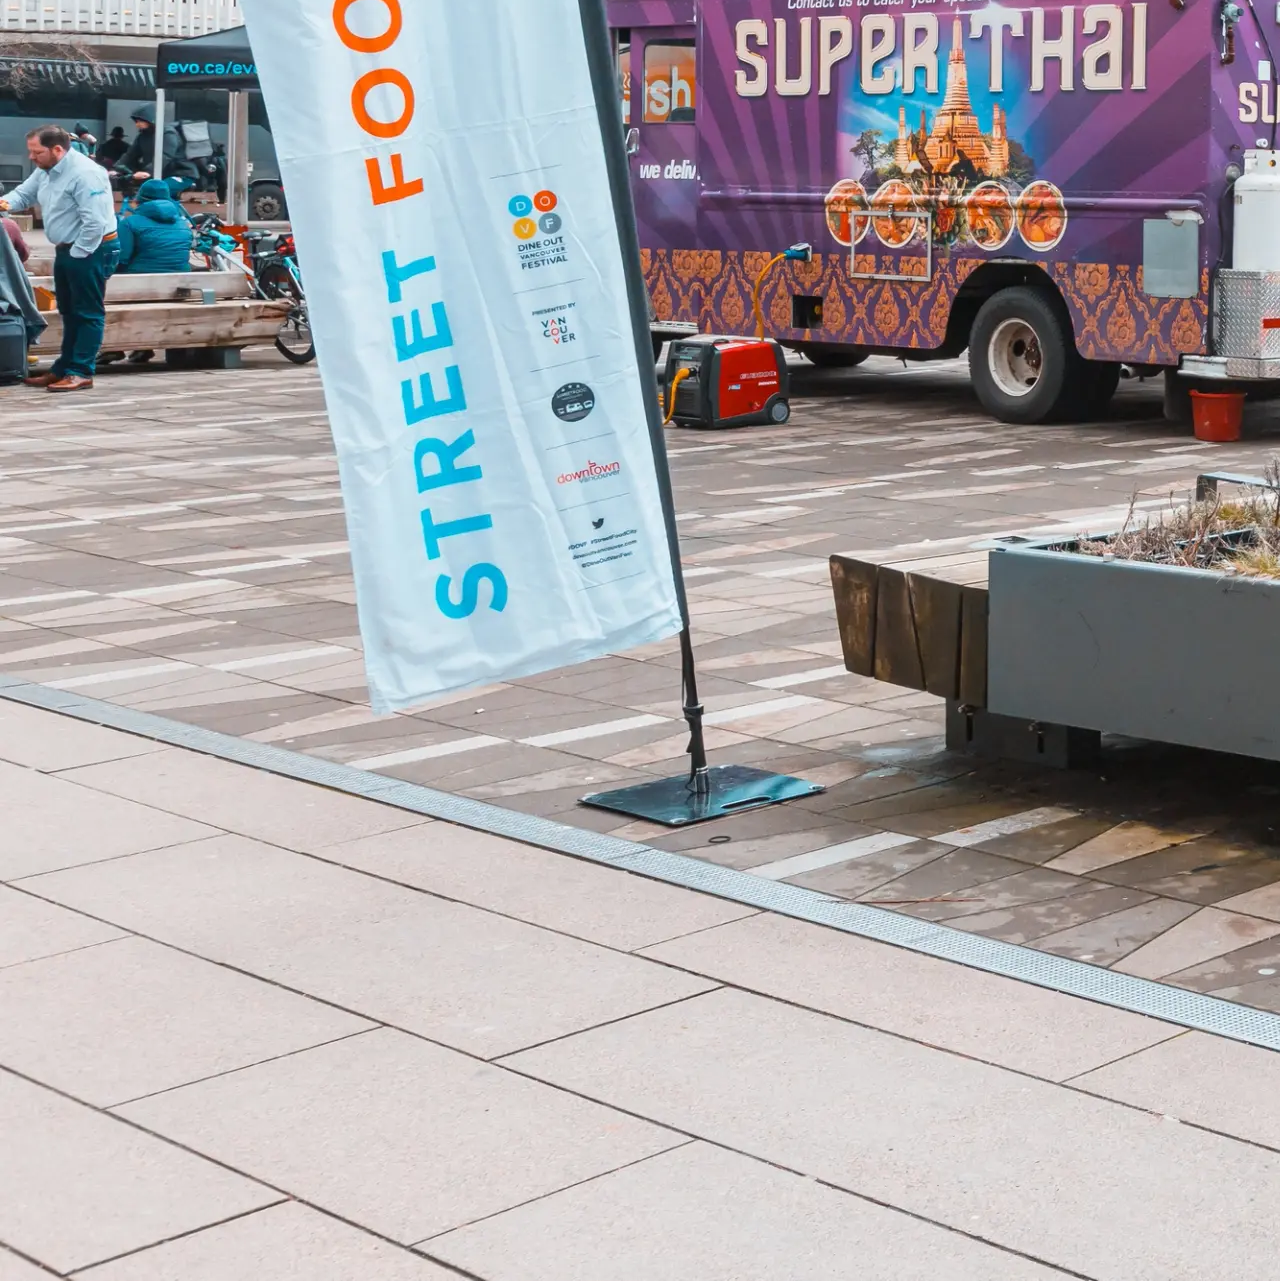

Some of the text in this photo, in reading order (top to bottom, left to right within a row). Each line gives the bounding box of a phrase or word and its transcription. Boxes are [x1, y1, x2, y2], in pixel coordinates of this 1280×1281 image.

[640, 160, 696, 180] we deliv
[518, 236, 563, 252] DINE OUT
[520, 246, 565, 260] VANCOUVER
[521, 255, 568, 270] FESTIVAL
[532, 304, 567, 316] PRESENTED
[541, 316, 566, 328] VAN
[543, 325, 568, 338] COU
[553, 332, 576, 345] VER
[381, 250, 508, 619] STREET
[557, 460, 620, 484] downtown
[579, 469, 620, 484] vancouver
